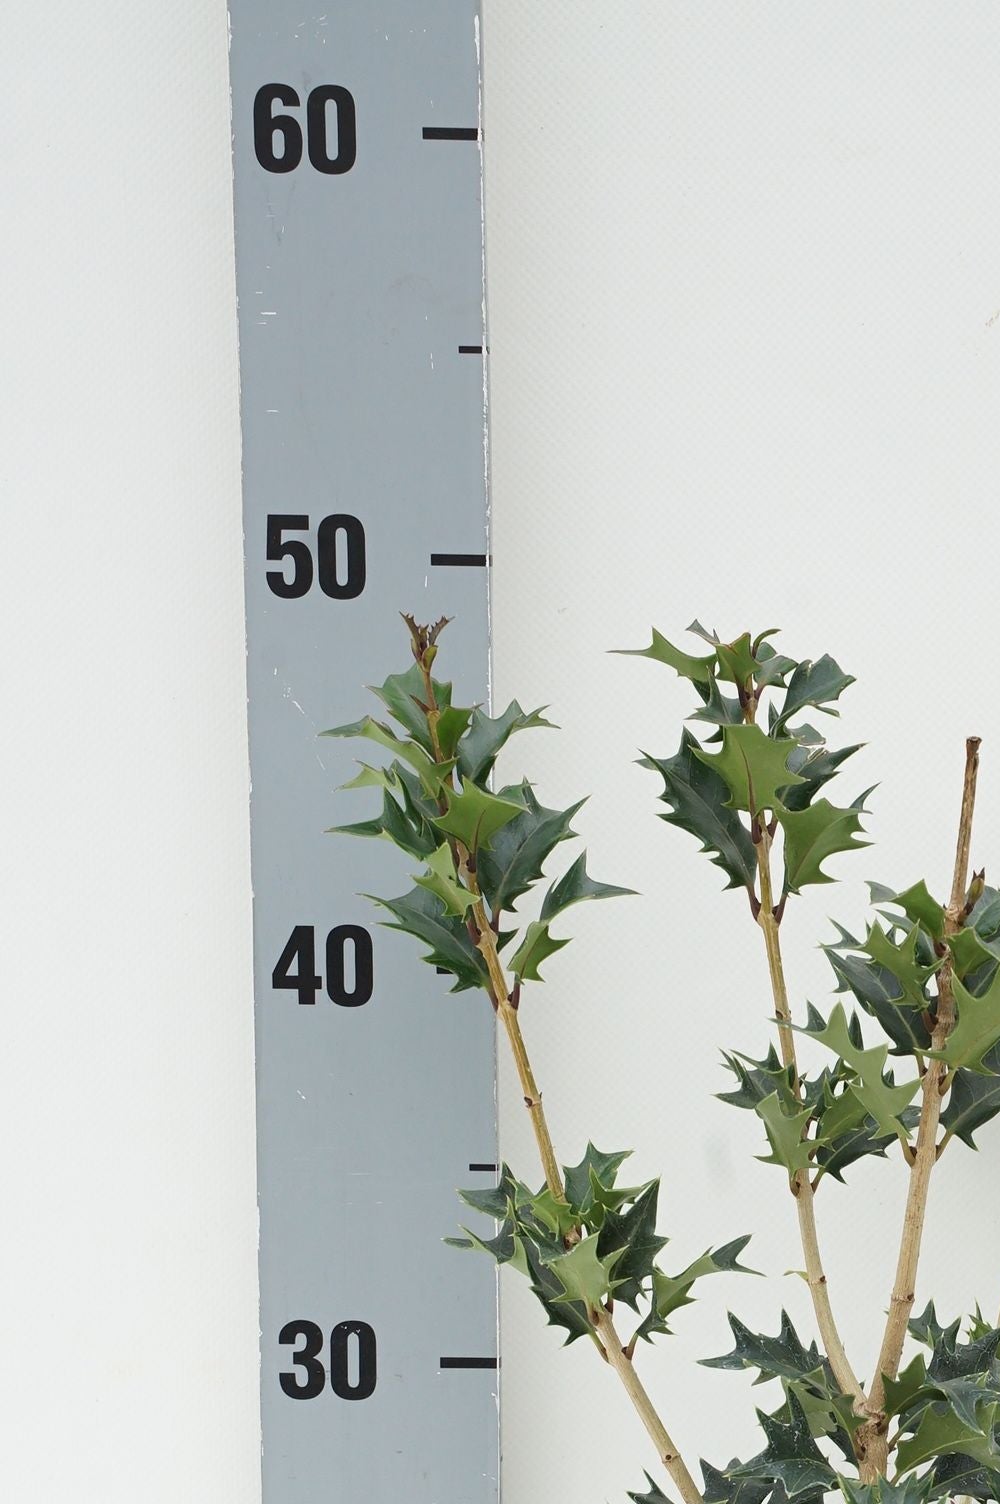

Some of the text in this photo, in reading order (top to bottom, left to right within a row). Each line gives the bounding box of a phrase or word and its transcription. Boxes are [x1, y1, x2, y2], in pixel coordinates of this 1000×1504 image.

[252, 83, 357, 175] 60
[264, 513, 367, 600] 50
[270, 924, 375, 1008] 40
[277, 1319, 377, 1401] 30
